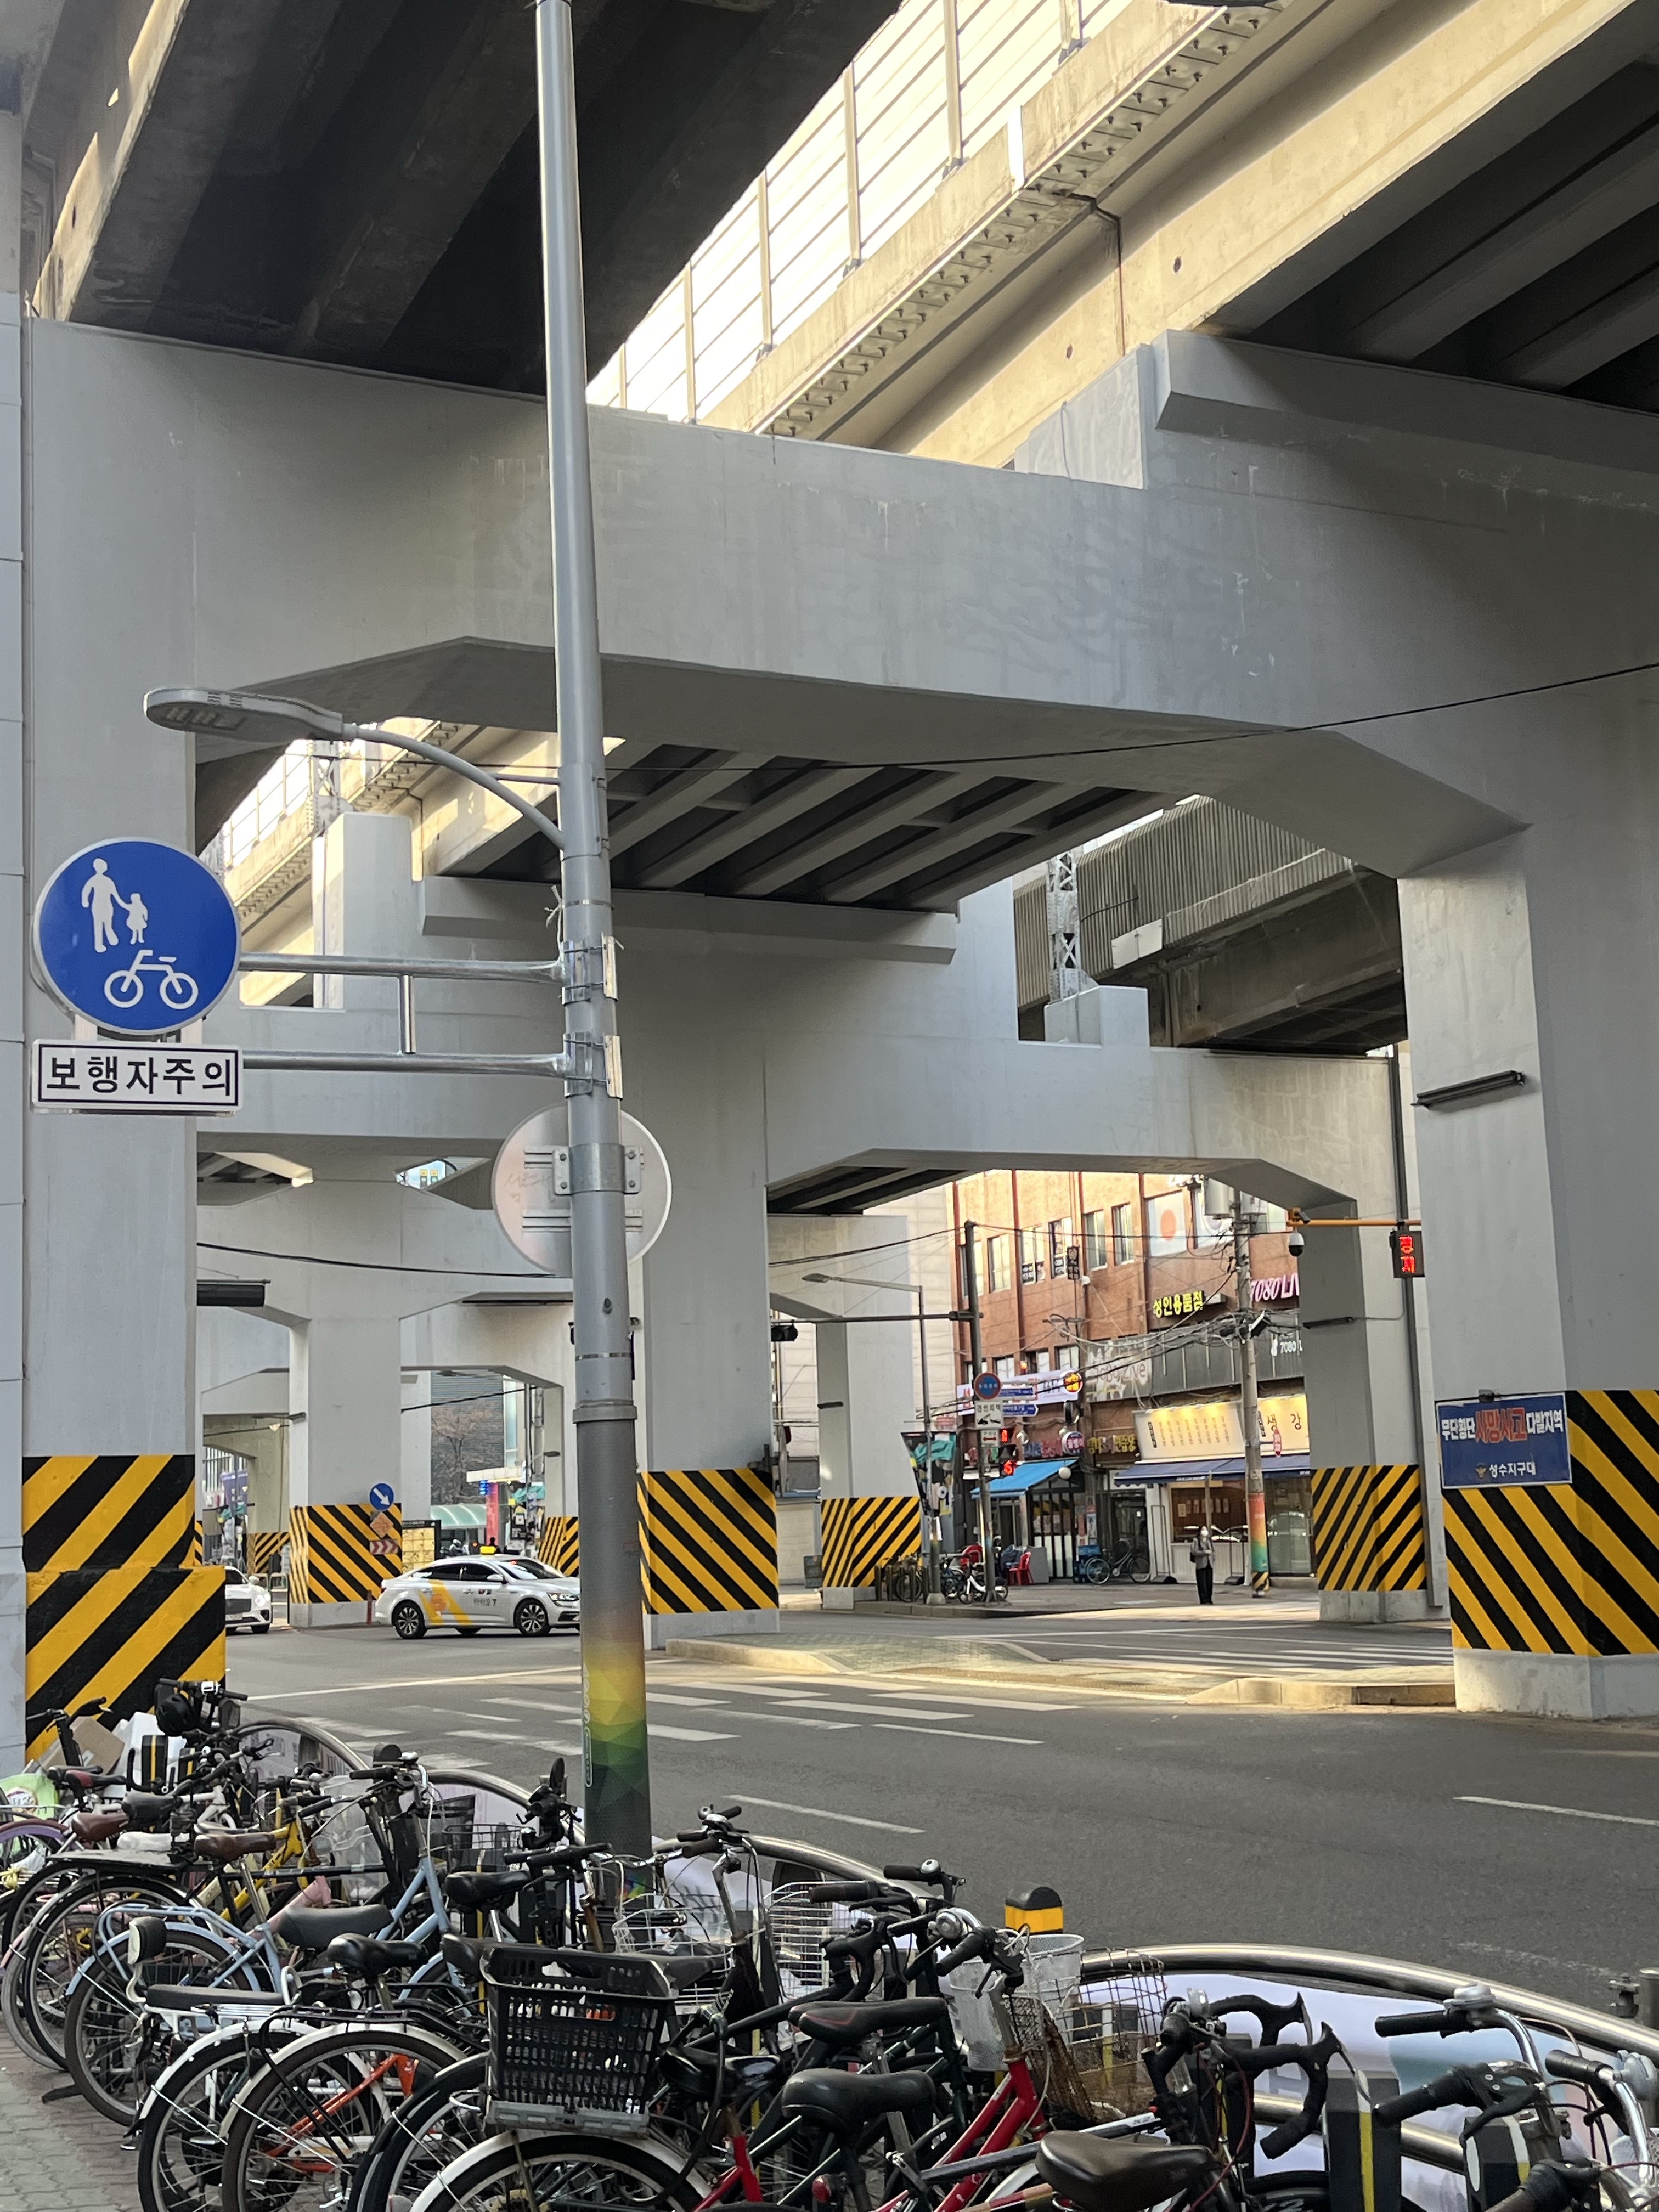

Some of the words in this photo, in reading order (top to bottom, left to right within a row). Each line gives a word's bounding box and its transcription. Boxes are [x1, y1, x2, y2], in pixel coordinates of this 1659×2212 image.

[46, 1055, 232, 1097] 보행자주의
[1153, 1290, 1204, 1319] 성인용품점
[1251, 1278, 1282, 1302] 7080
[1441, 1416, 1476, 1441] 무단횡단
[1475, 1407, 1528, 1444] 사망사고
[1526, 1409, 1564, 1435] 다발지역
[1488, 1460, 1537, 1479] 성수지구대
